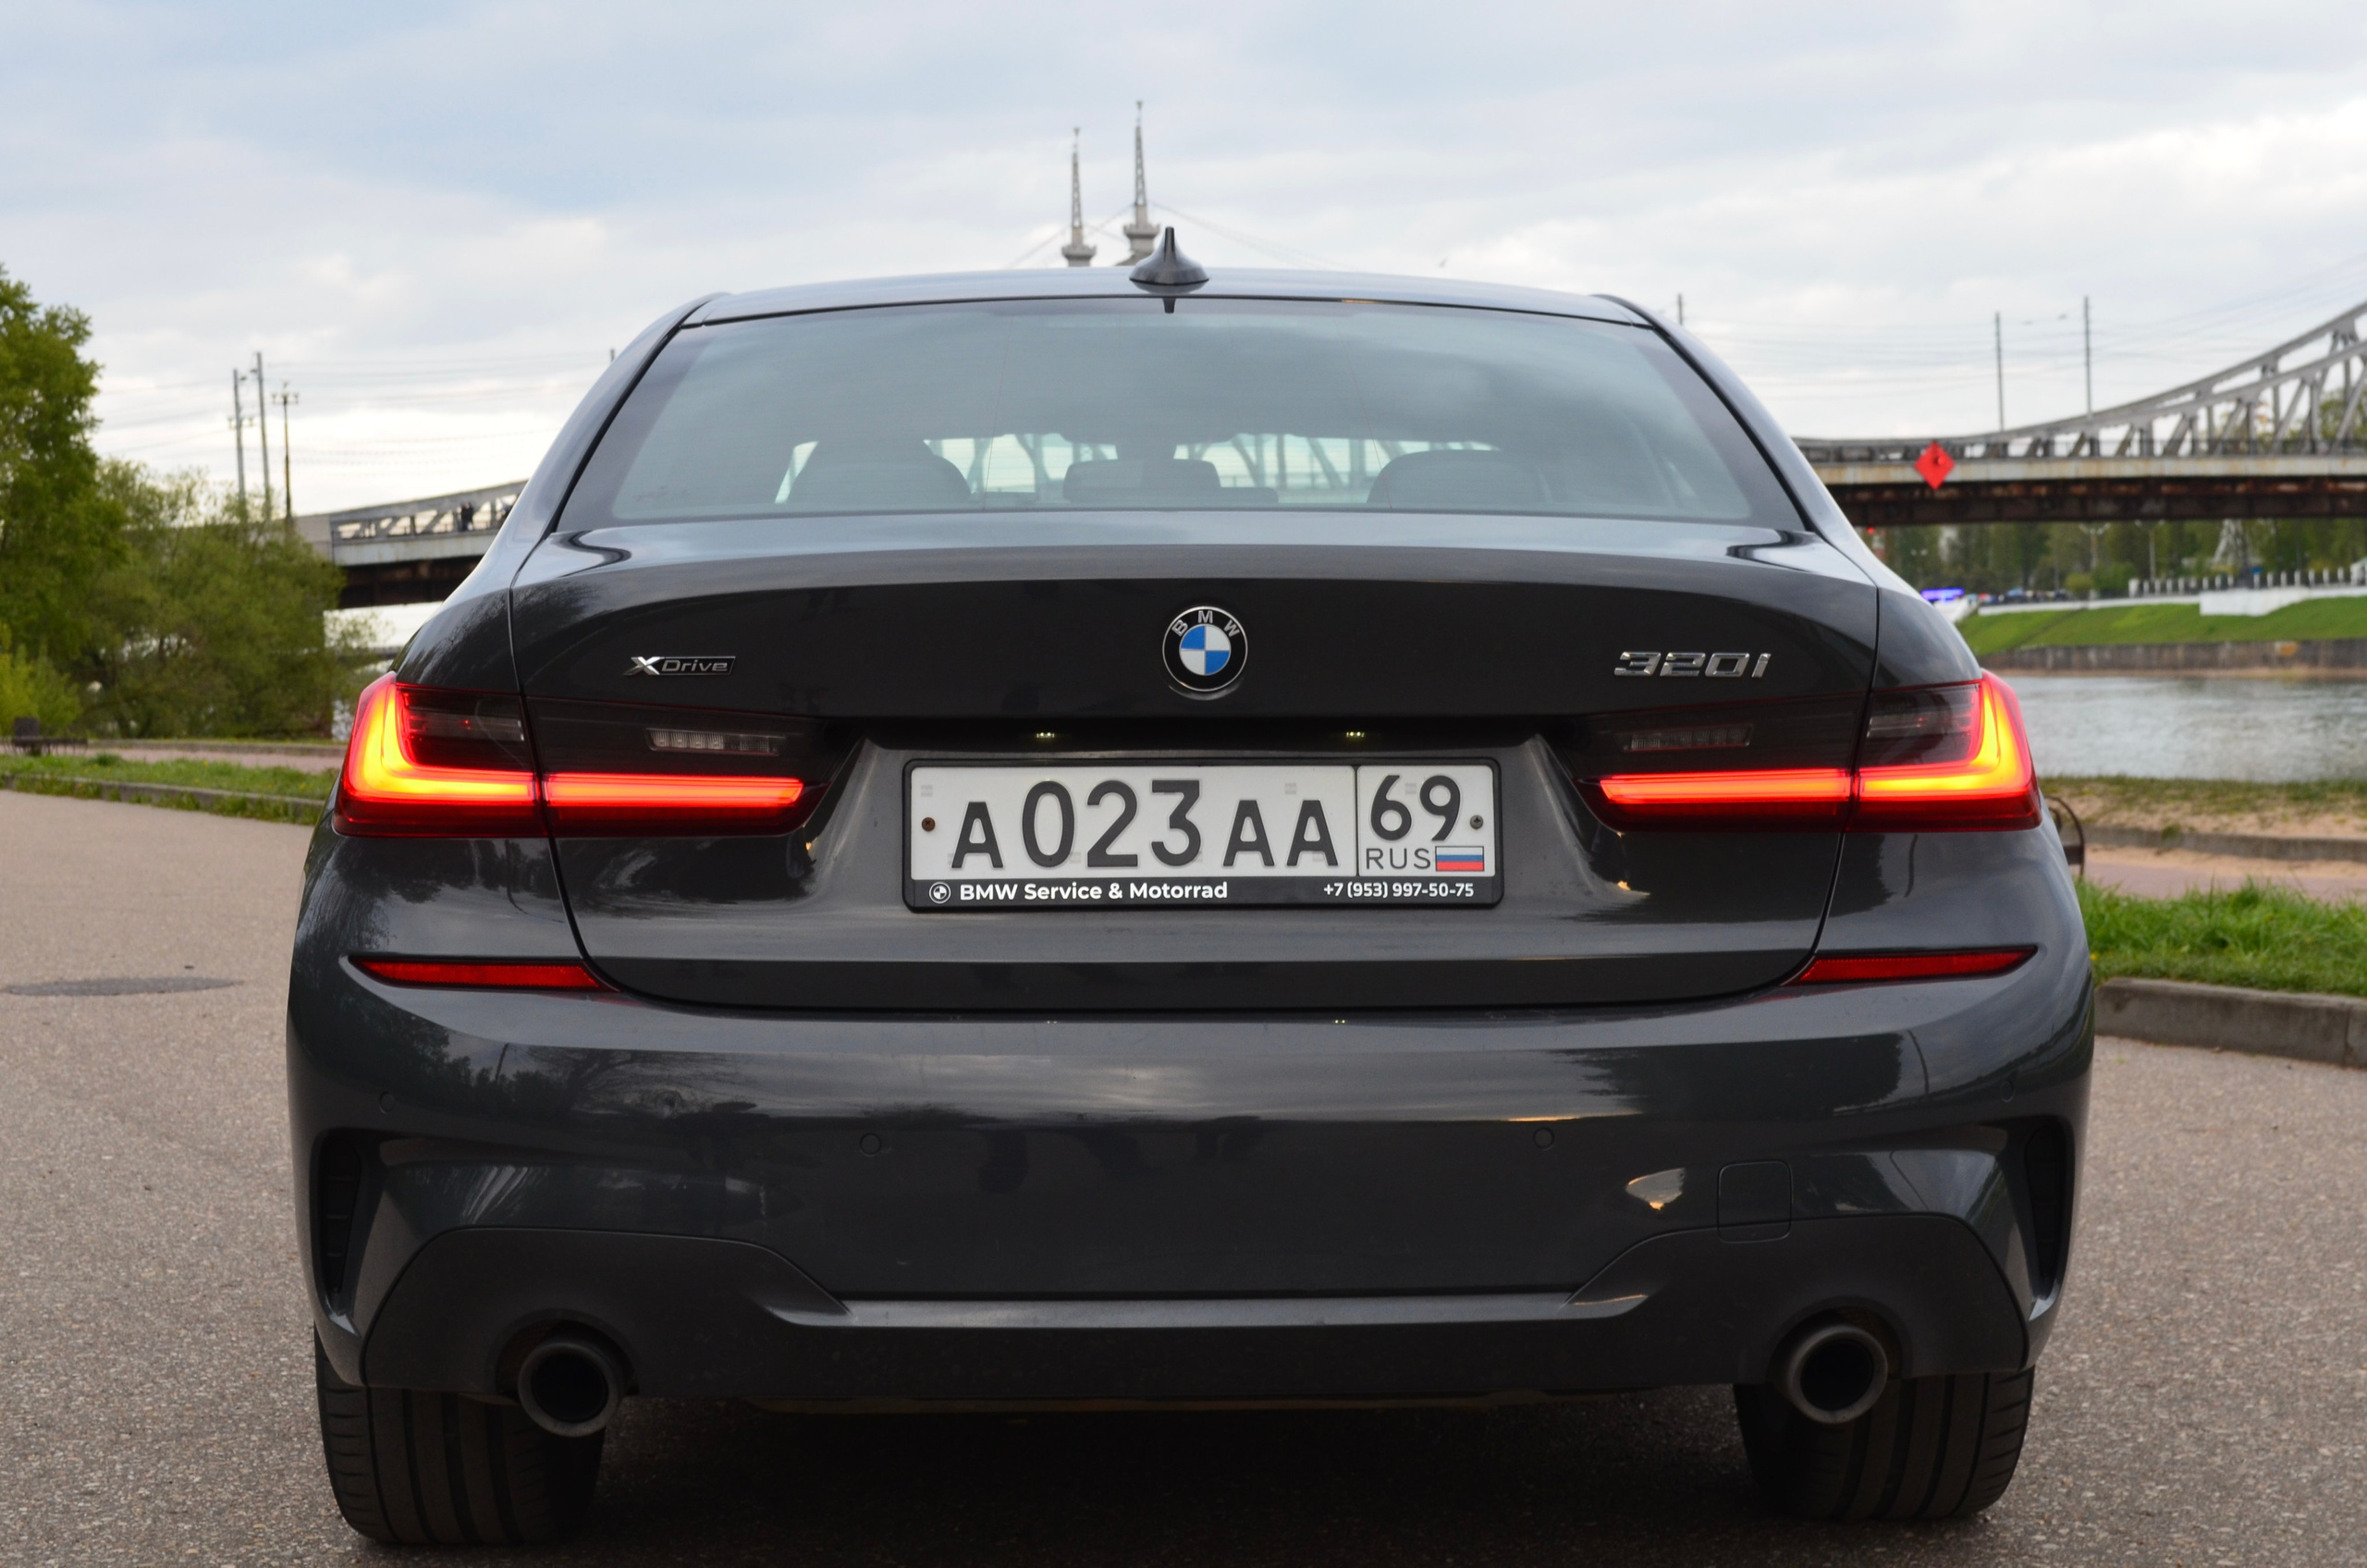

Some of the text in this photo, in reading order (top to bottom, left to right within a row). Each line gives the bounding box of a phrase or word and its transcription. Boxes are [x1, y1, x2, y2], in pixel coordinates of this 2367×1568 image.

[1171, 609, 1240, 638] BMW
[1614, 651, 1772, 678] 320i
[1370, 774, 1461, 841] 69
[1366, 848, 1431, 870] RUS
[960, 881, 1228, 900] BMW Service & Motorrad
[1324, 881, 1474, 899] +7 (953) 997-50-75
